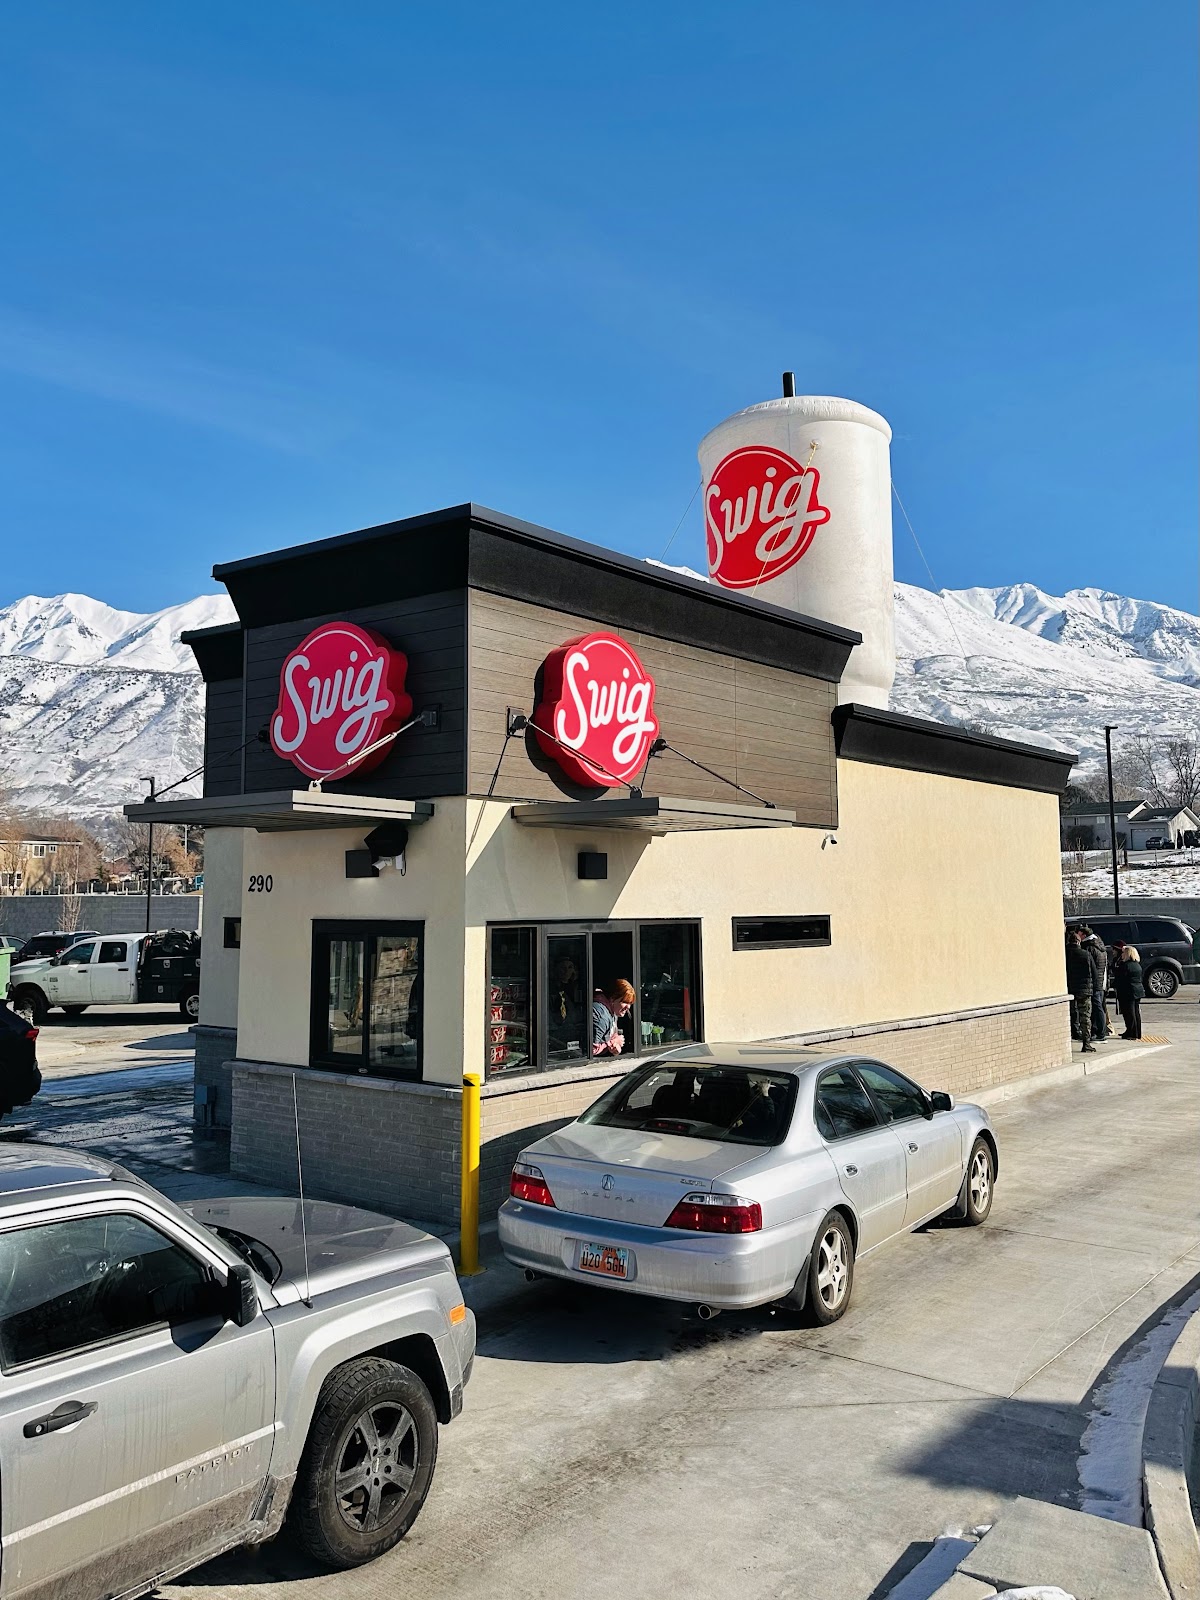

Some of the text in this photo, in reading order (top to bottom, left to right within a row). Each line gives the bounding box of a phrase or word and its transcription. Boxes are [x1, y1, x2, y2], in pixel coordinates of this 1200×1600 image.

[705, 466, 827, 574] Swig
[273, 650, 390, 755] Swig
[556, 652, 656, 765] Swig
[247, 874, 273, 893] 290
[580, 1189, 635, 1203] ACURA
[582, 1250, 601, 1269] U20
[606, 1255, 625, 1274] 5GH
[175, 1440, 256, 1484] PATRIOT
